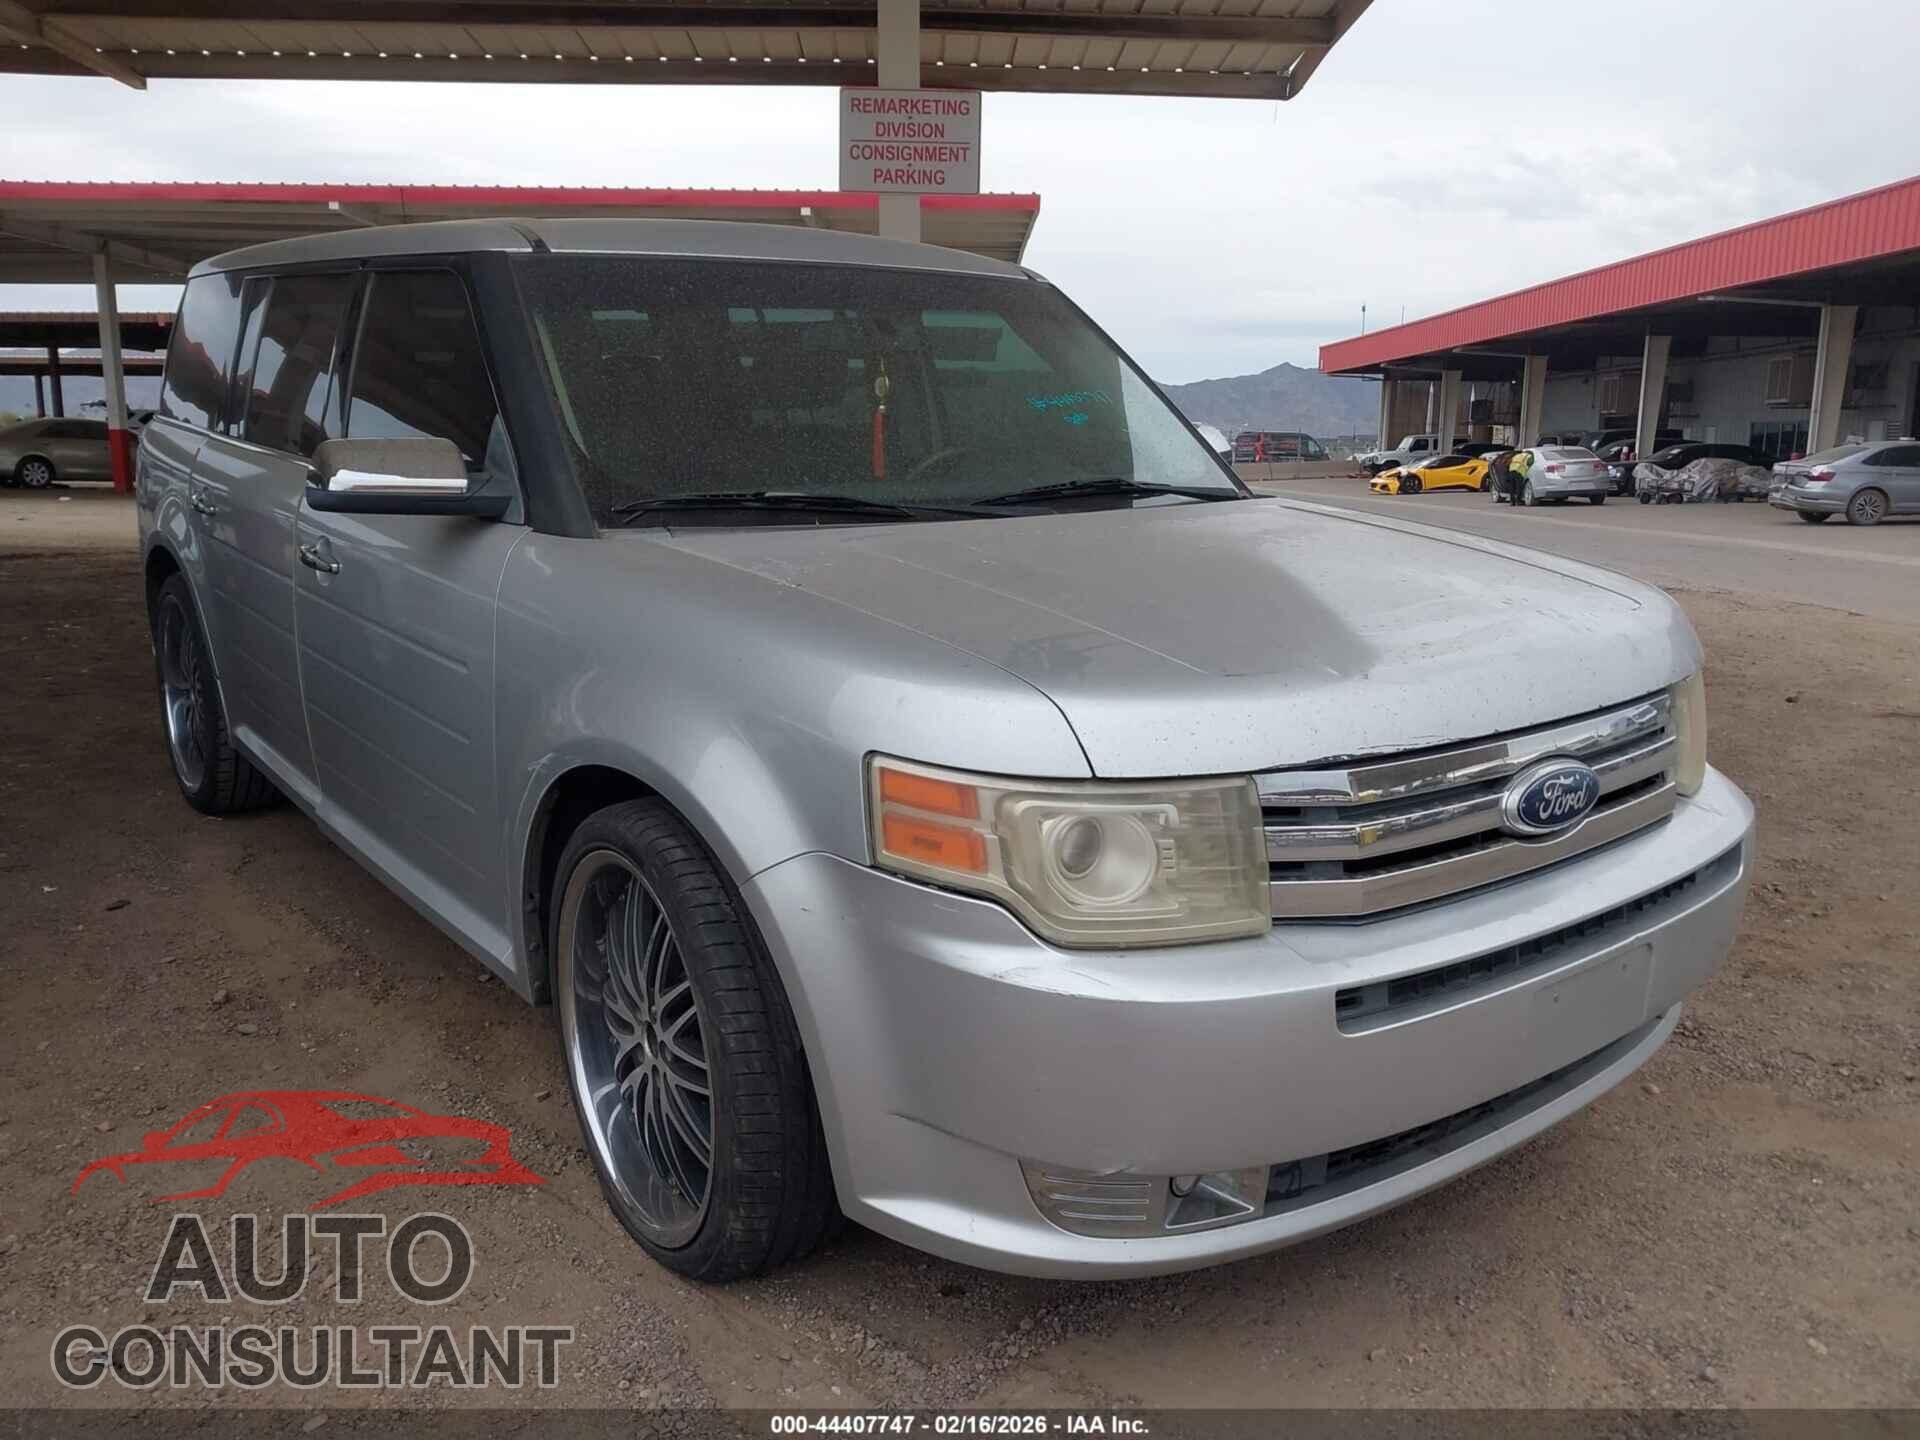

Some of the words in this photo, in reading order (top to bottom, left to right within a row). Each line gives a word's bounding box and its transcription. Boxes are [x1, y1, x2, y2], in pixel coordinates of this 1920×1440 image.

[850, 97, 970, 116] REMARKETING
[875, 121, 945, 138] DIVISION
[850, 144, 970, 162] CONSIGNMENT
[873, 168, 945, 185] PARKING
[1539, 774, 1587, 820] Ford
